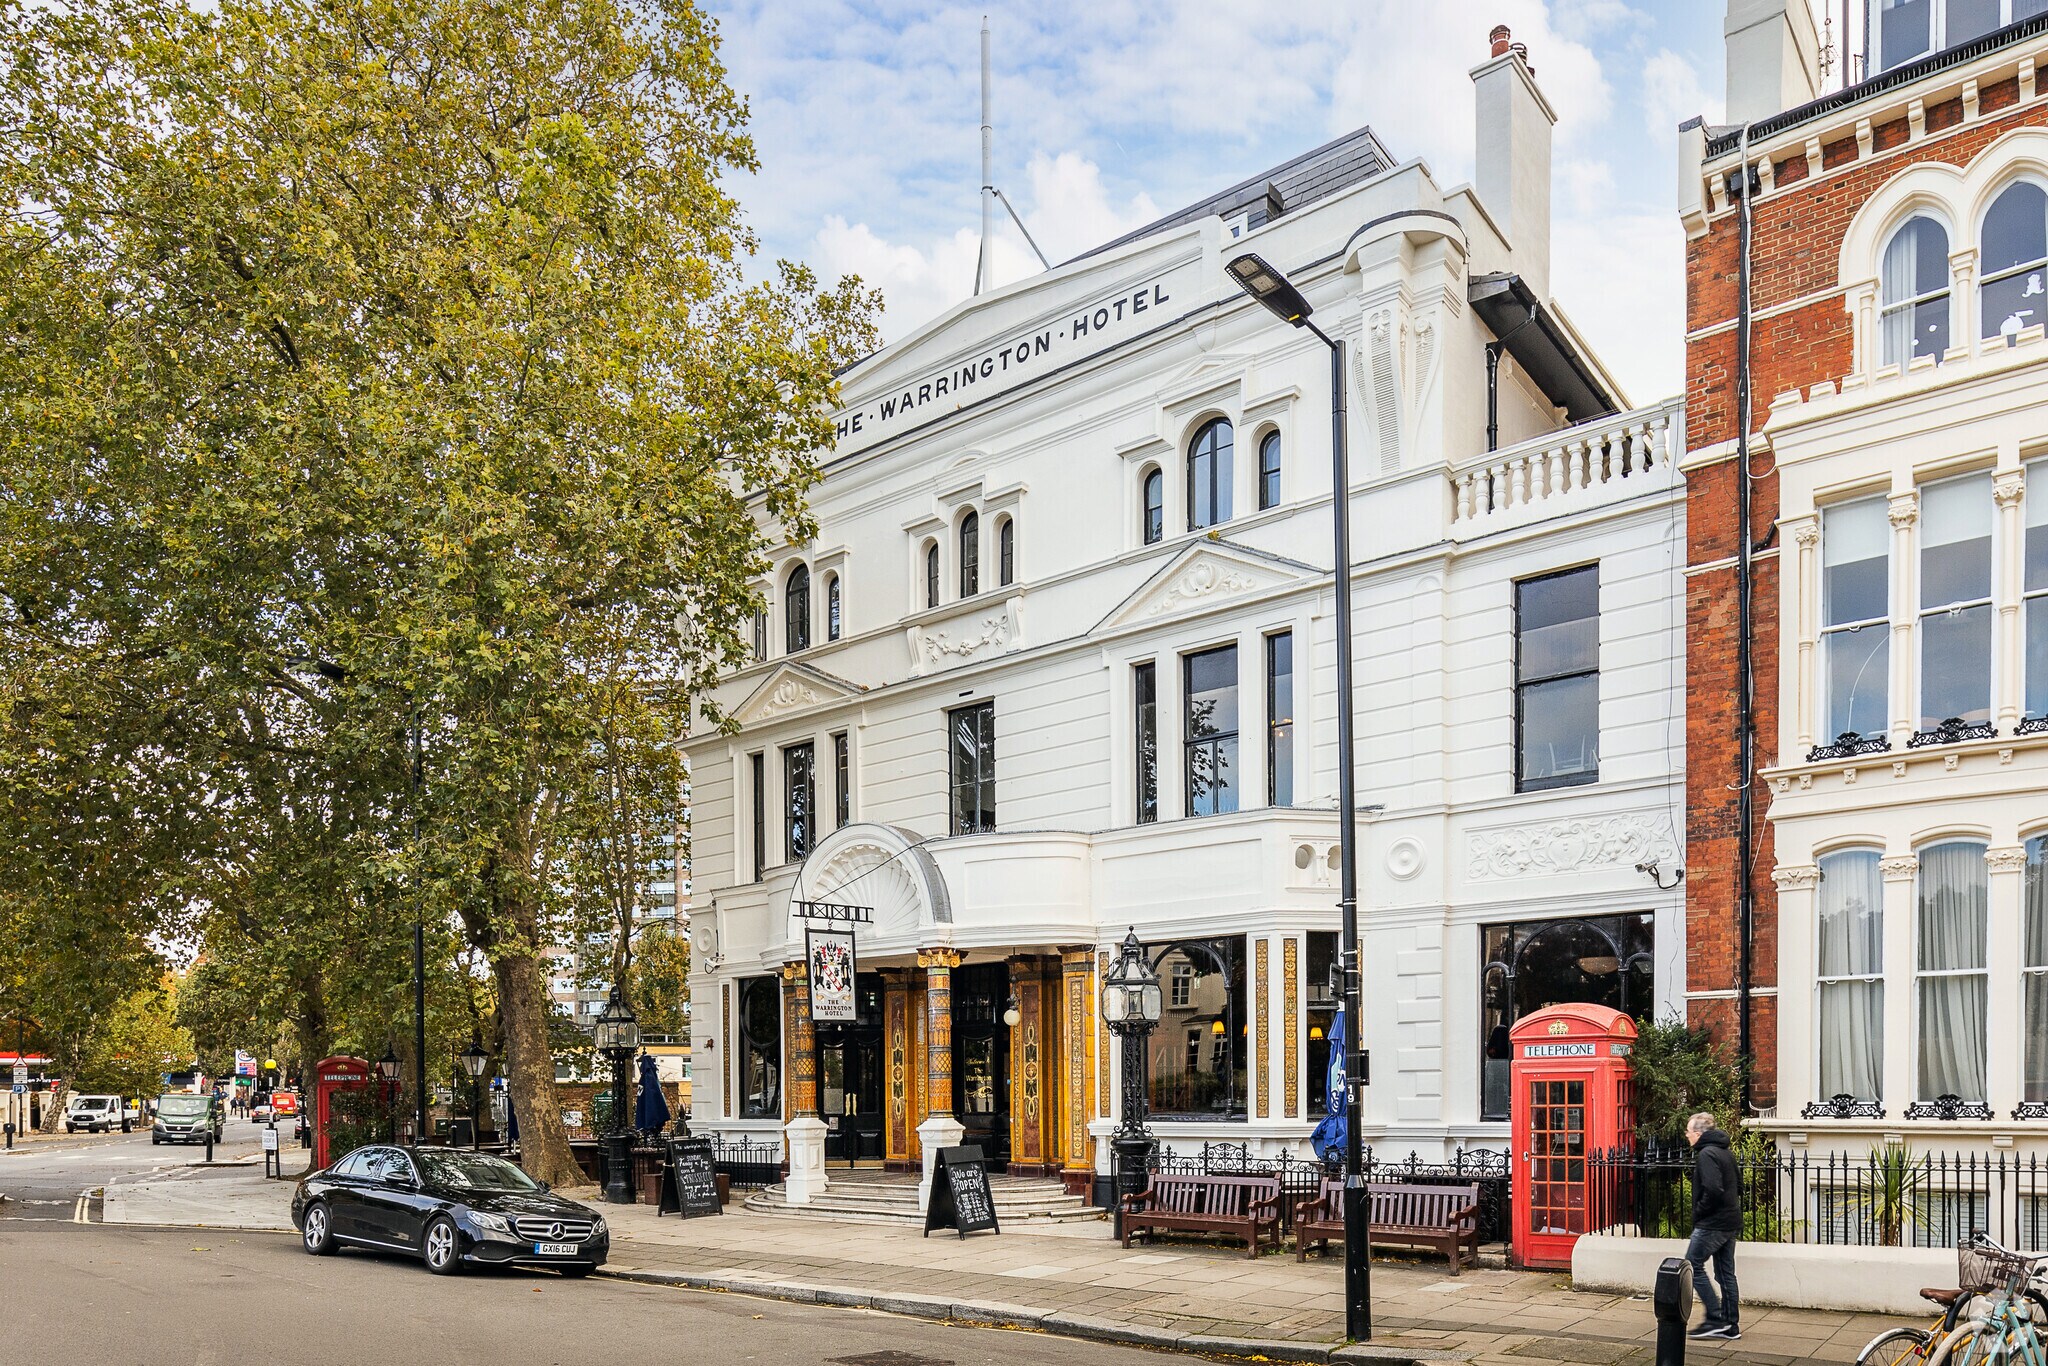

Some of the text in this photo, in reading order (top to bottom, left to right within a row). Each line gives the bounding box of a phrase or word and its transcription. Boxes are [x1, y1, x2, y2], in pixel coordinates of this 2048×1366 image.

[836, 284, 1169, 441] HE WARRINGTON HOTEL
[1527, 1044, 1594, 1057] TELEPHONE
[953, 1169, 978, 1179] We are
[959, 1178, 980, 1191] OPEN
[542, 1244, 576, 1253] GX16 CUJ
